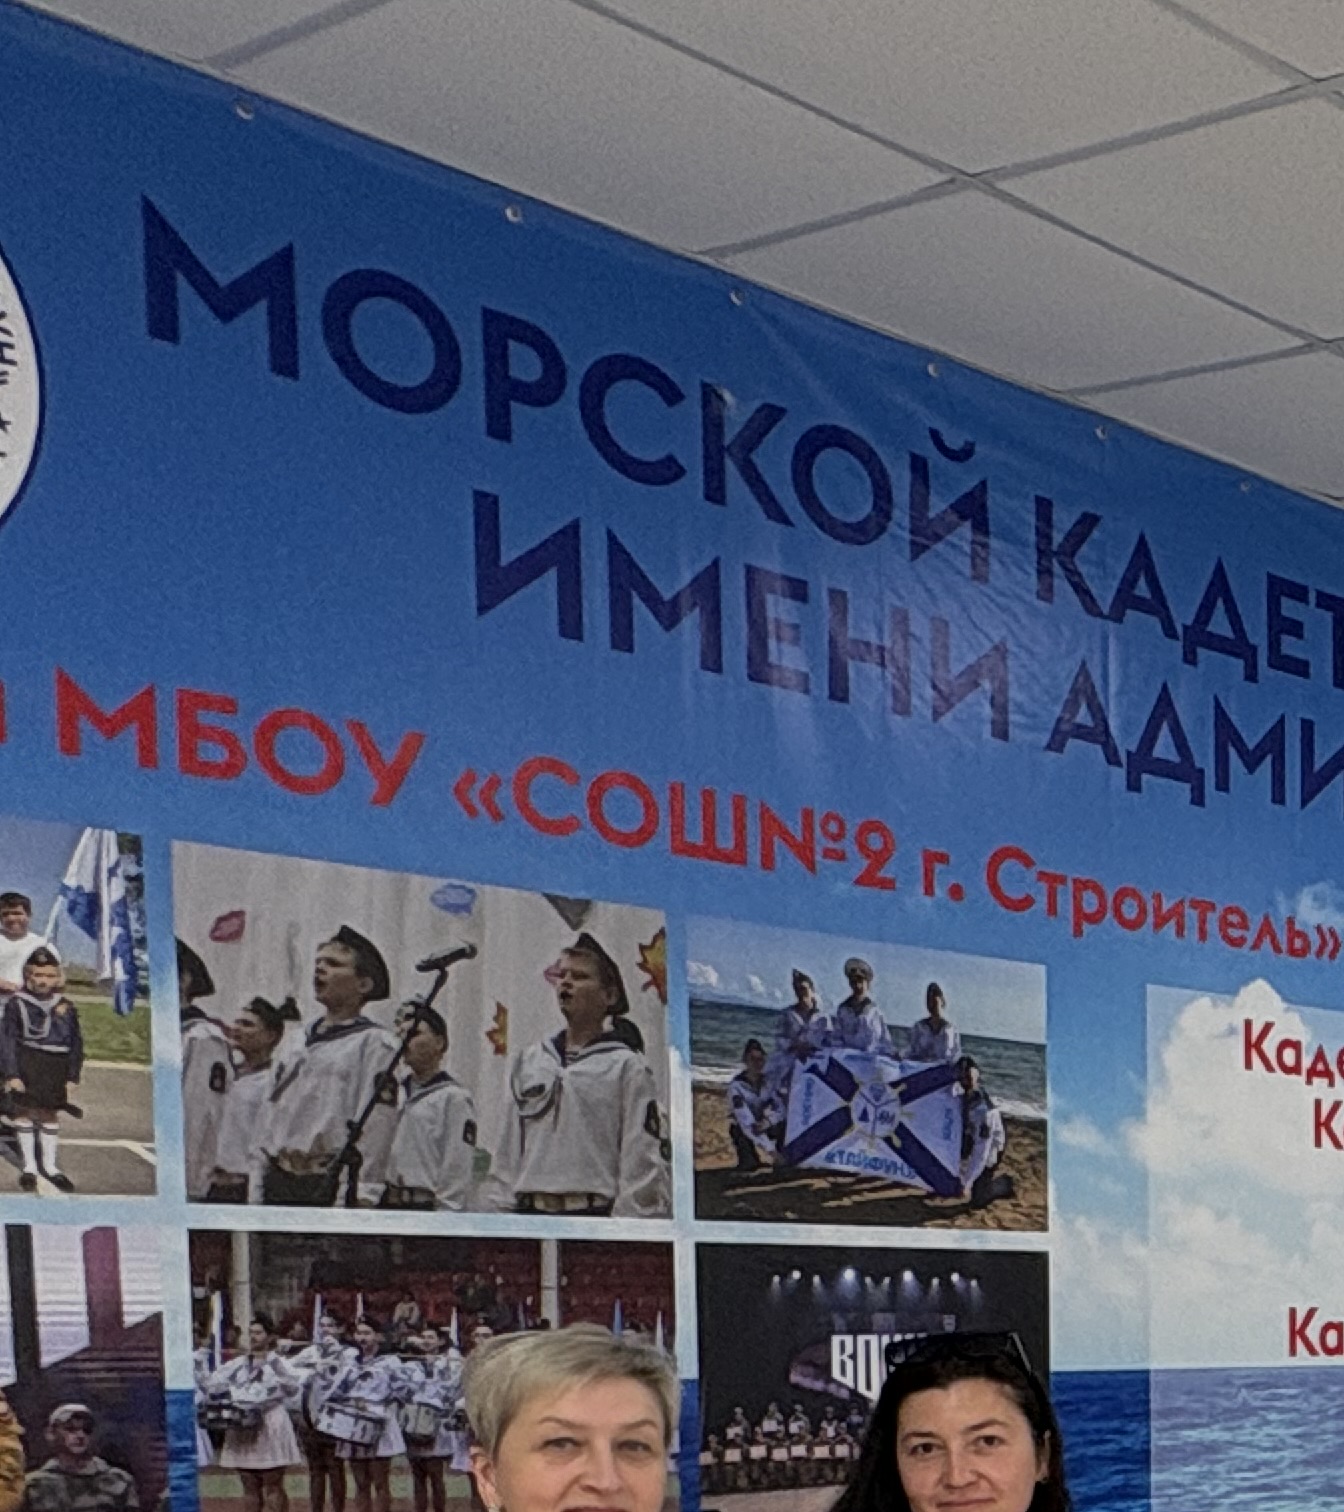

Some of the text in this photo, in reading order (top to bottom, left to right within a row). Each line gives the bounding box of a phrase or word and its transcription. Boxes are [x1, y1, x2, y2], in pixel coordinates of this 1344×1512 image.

[141, 190, 990, 585] МОРСКОЙ
[472, 488, 1010, 743] ИМЕНИ
[55, 664, 426, 806] МБОУ
[452, 755, 896, 891] «СОШ№2
[922, 847, 965, 902] г.
[985, 845, 1343, 962] Строитель»
